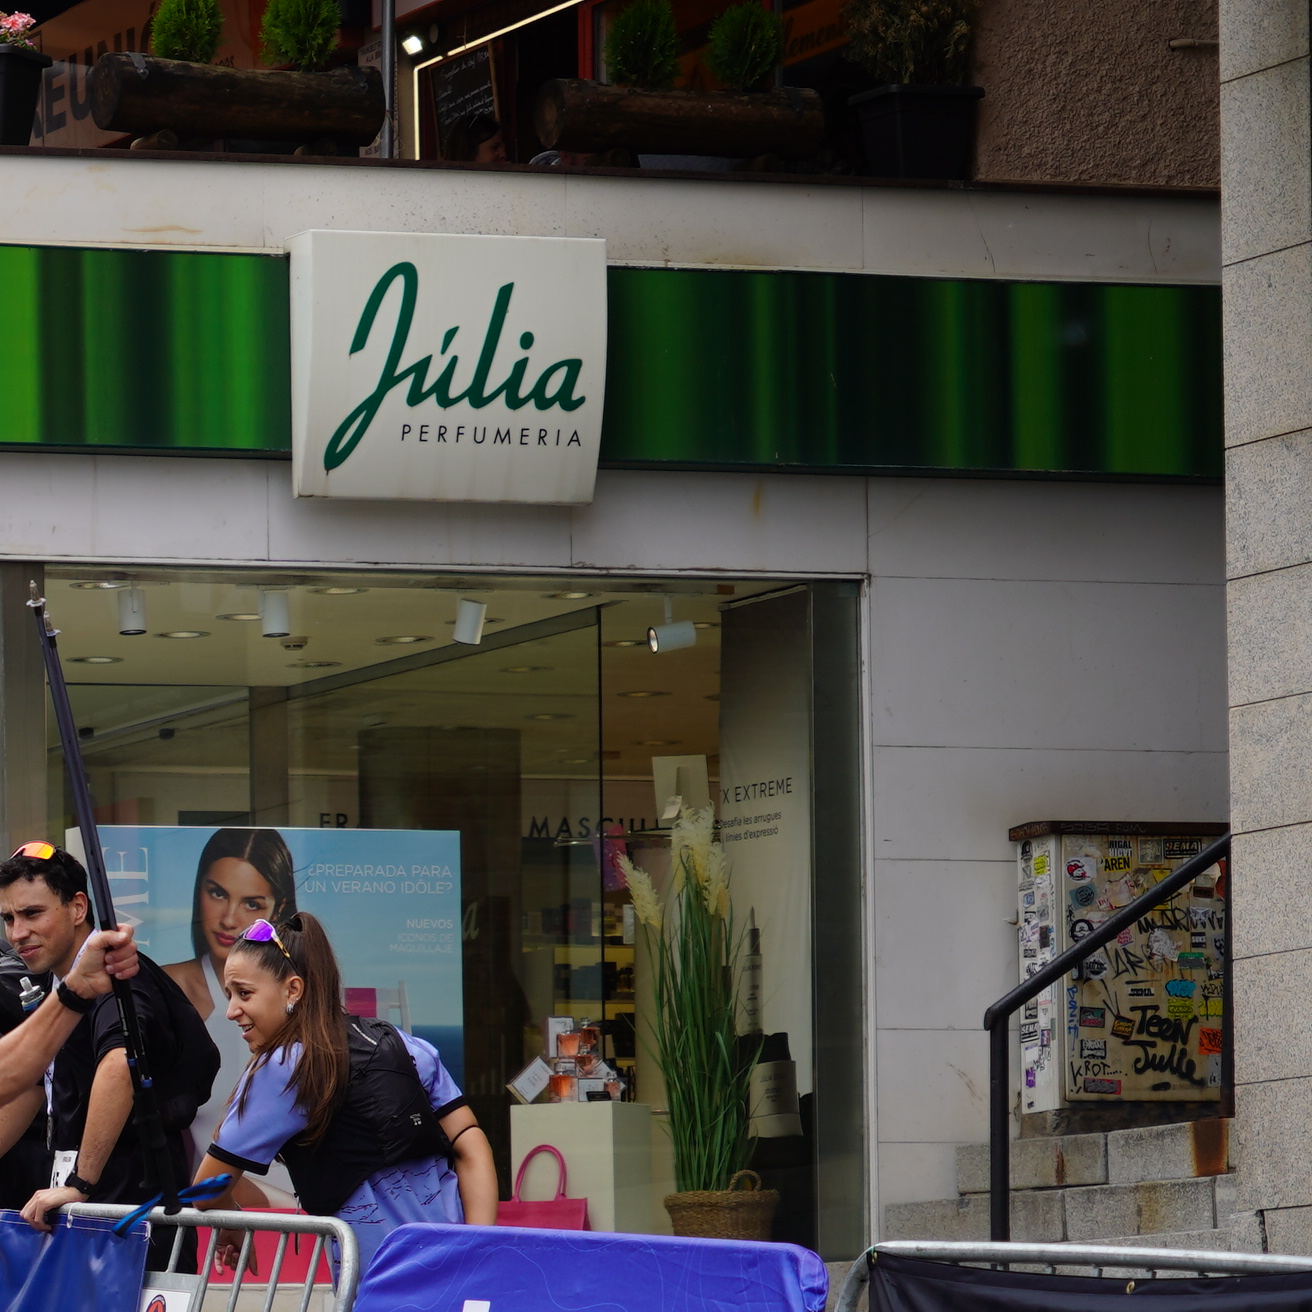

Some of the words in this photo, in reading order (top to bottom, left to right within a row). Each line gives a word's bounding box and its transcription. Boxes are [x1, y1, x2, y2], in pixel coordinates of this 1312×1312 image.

[323, 261, 586, 472] Júlia
[401, 424, 582, 447] PERFUMERIA
[734, 777, 794, 805] EXTREME
[743, 815, 753, 826] les
[307, 864, 407, 879] ¿PREPARADA
[411, 864, 452, 878] PARA
[304, 879, 328, 894] UN
[330, 880, 397, 895] VERANO
[406, 918, 453, 930] NUEVOS
[397, 932, 433, 944] ICONOS
[435, 932, 453, 944] DE
[388, 942, 454, 954] MAQUILLAJE
